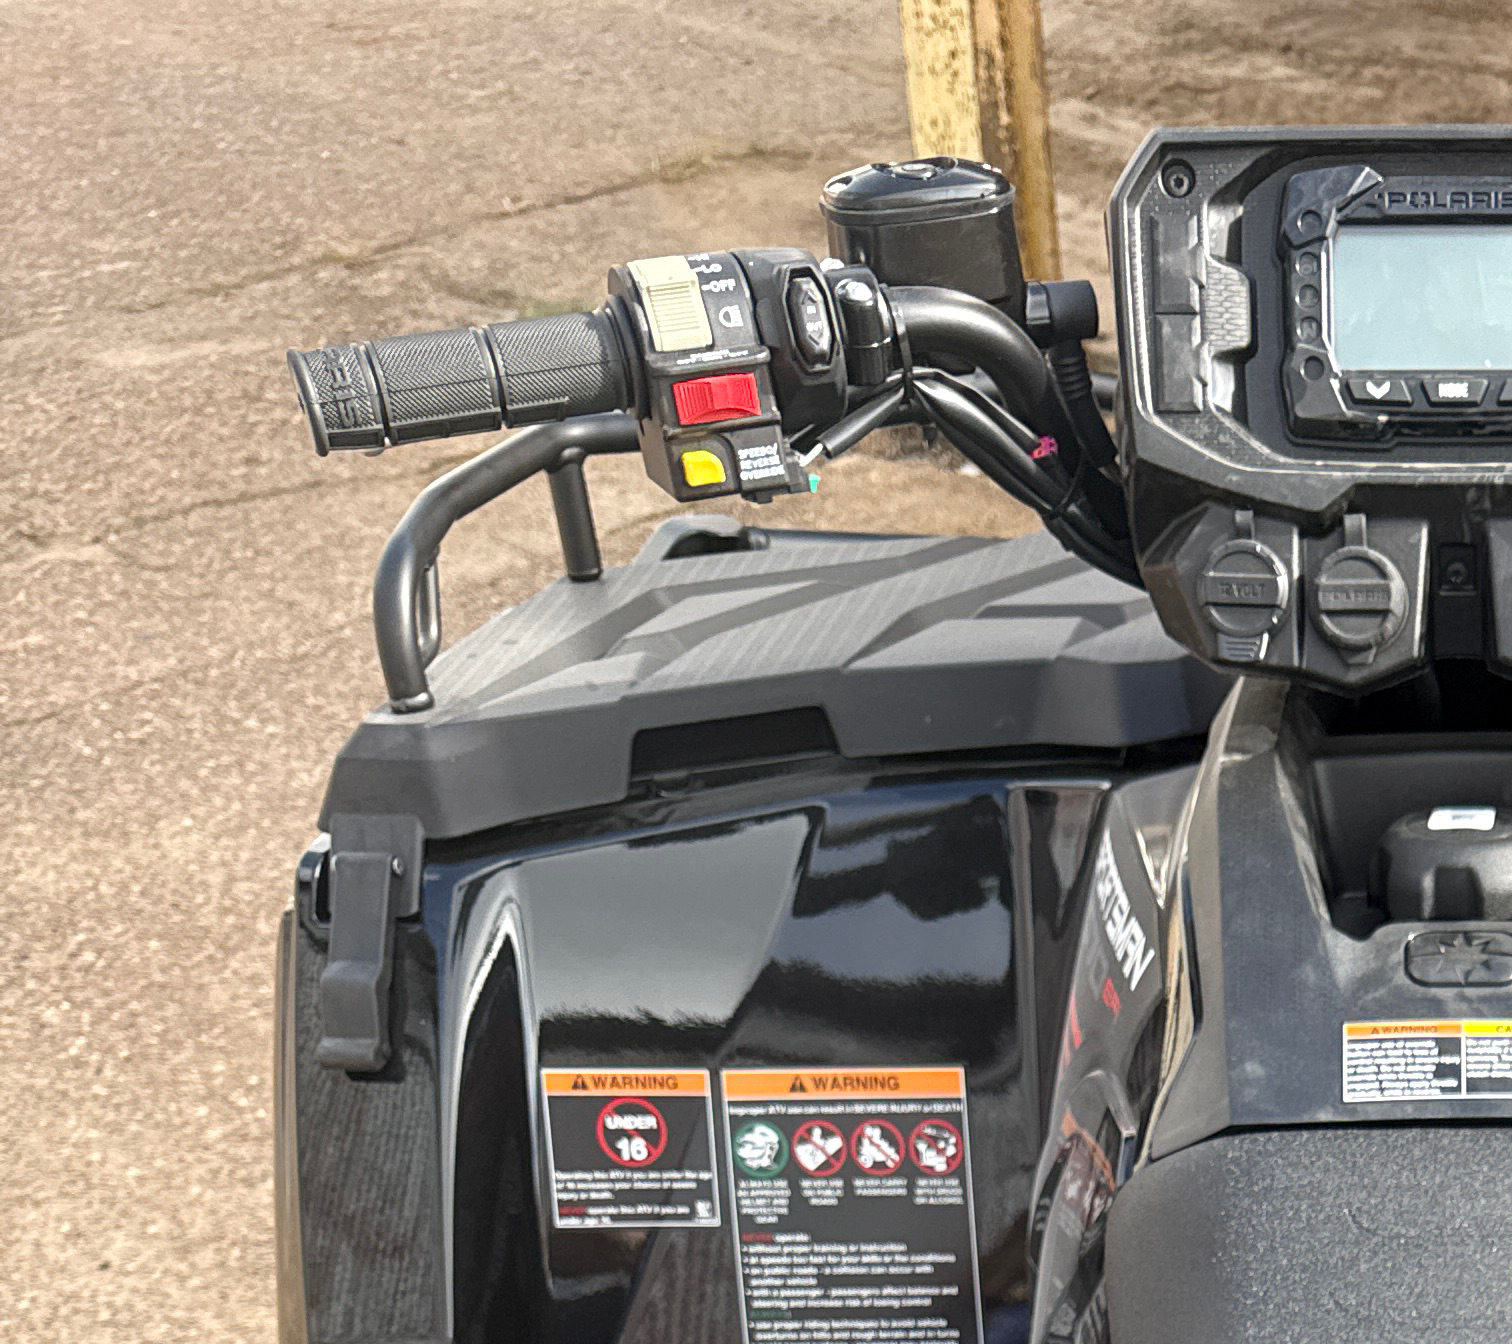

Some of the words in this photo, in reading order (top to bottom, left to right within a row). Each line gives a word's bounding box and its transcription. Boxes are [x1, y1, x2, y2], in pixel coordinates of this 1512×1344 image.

[709, 278, 737, 293] OFF
[1382, 1024, 1439, 1035] WARNING
[592, 1074, 680, 1091] WARNING
[812, 1075, 901, 1092] WARNING
[604, 1113, 658, 1130] UNDER
[615, 1136, 649, 1162] 16
